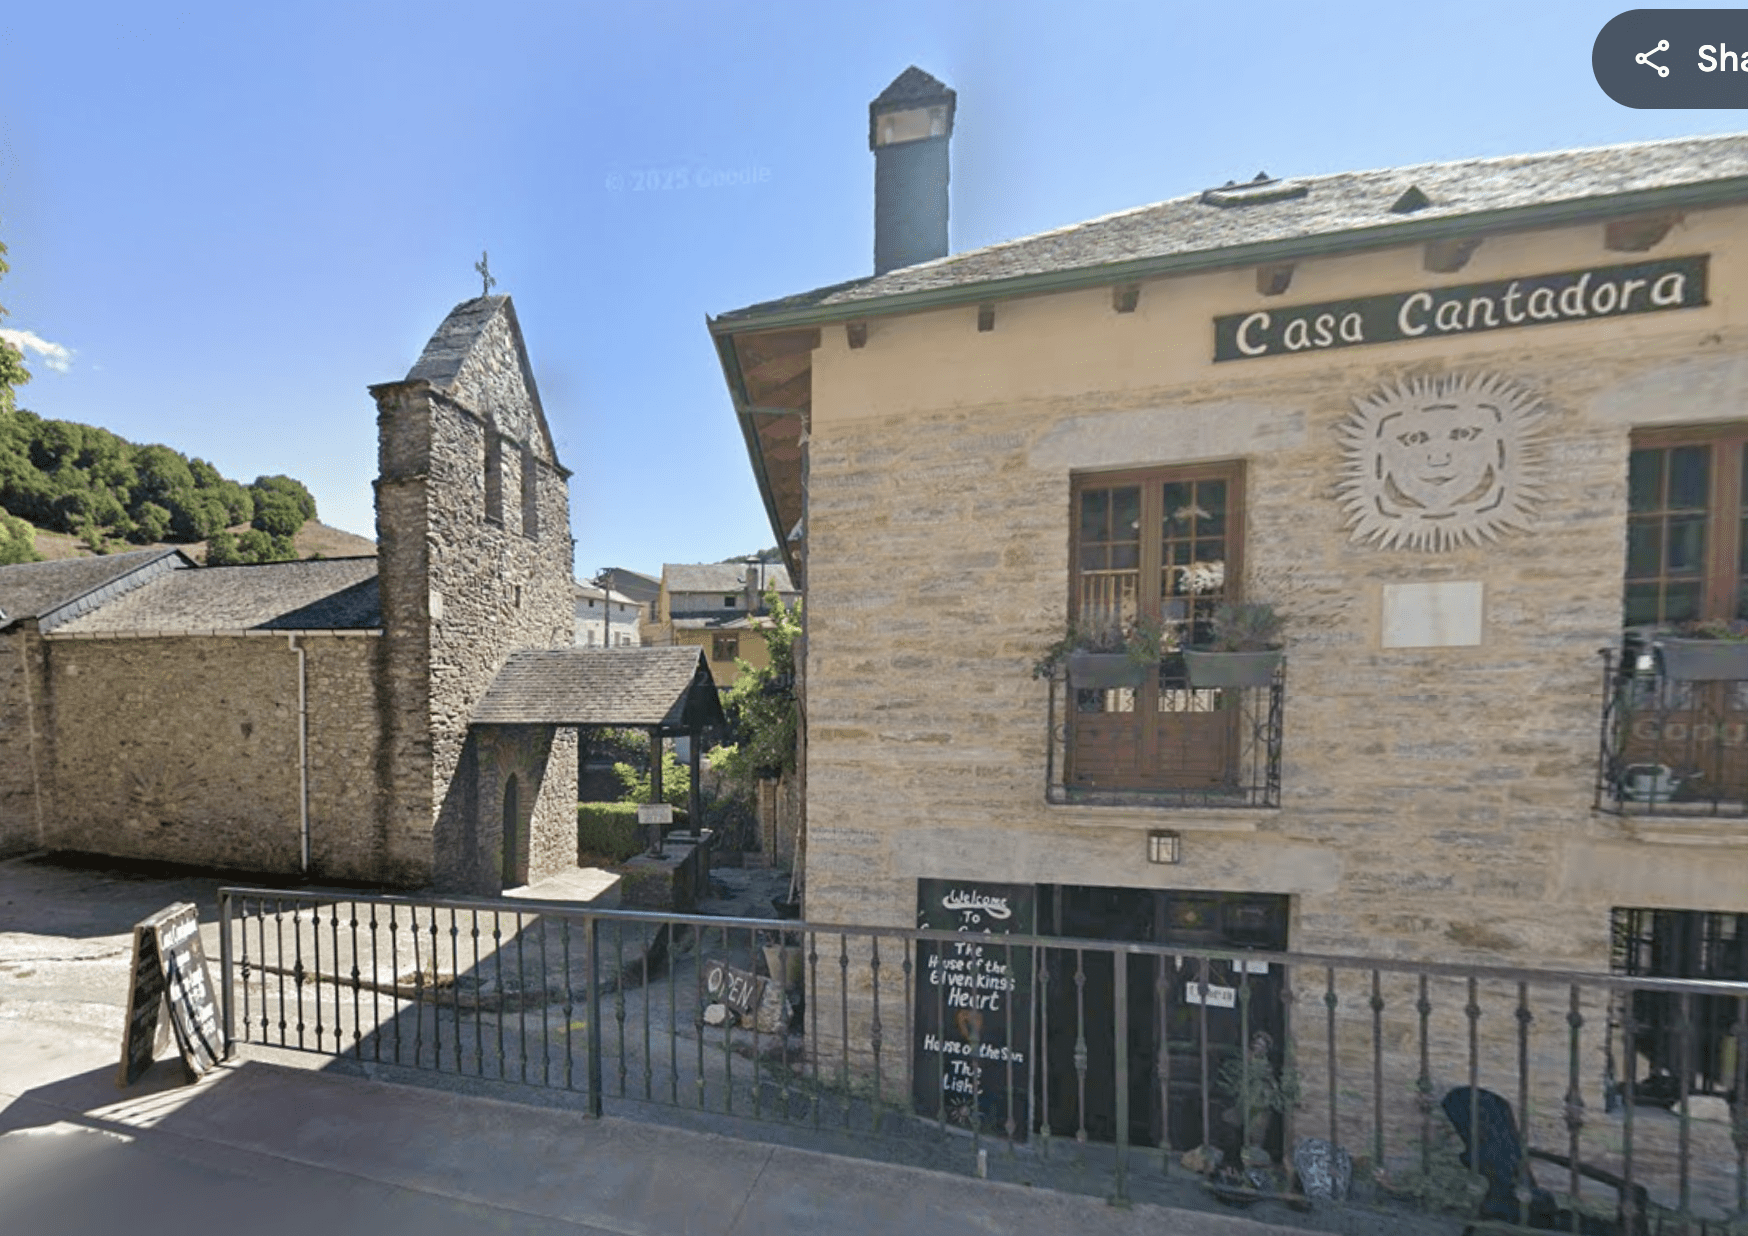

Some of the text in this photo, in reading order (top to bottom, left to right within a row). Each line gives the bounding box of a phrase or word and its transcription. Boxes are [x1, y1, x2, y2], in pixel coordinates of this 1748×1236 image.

[1235, 270, 1687, 357] Casa Cantadora
[943, 889, 1010, 914] Welcome
[962, 910, 981, 924] To
[954, 941, 983, 957] The
[928, 954, 964, 971] Huse
[707, 967, 754, 1008] OPEN
[929, 969, 973, 988] Elven
[948, 986, 999, 1011] Heart
